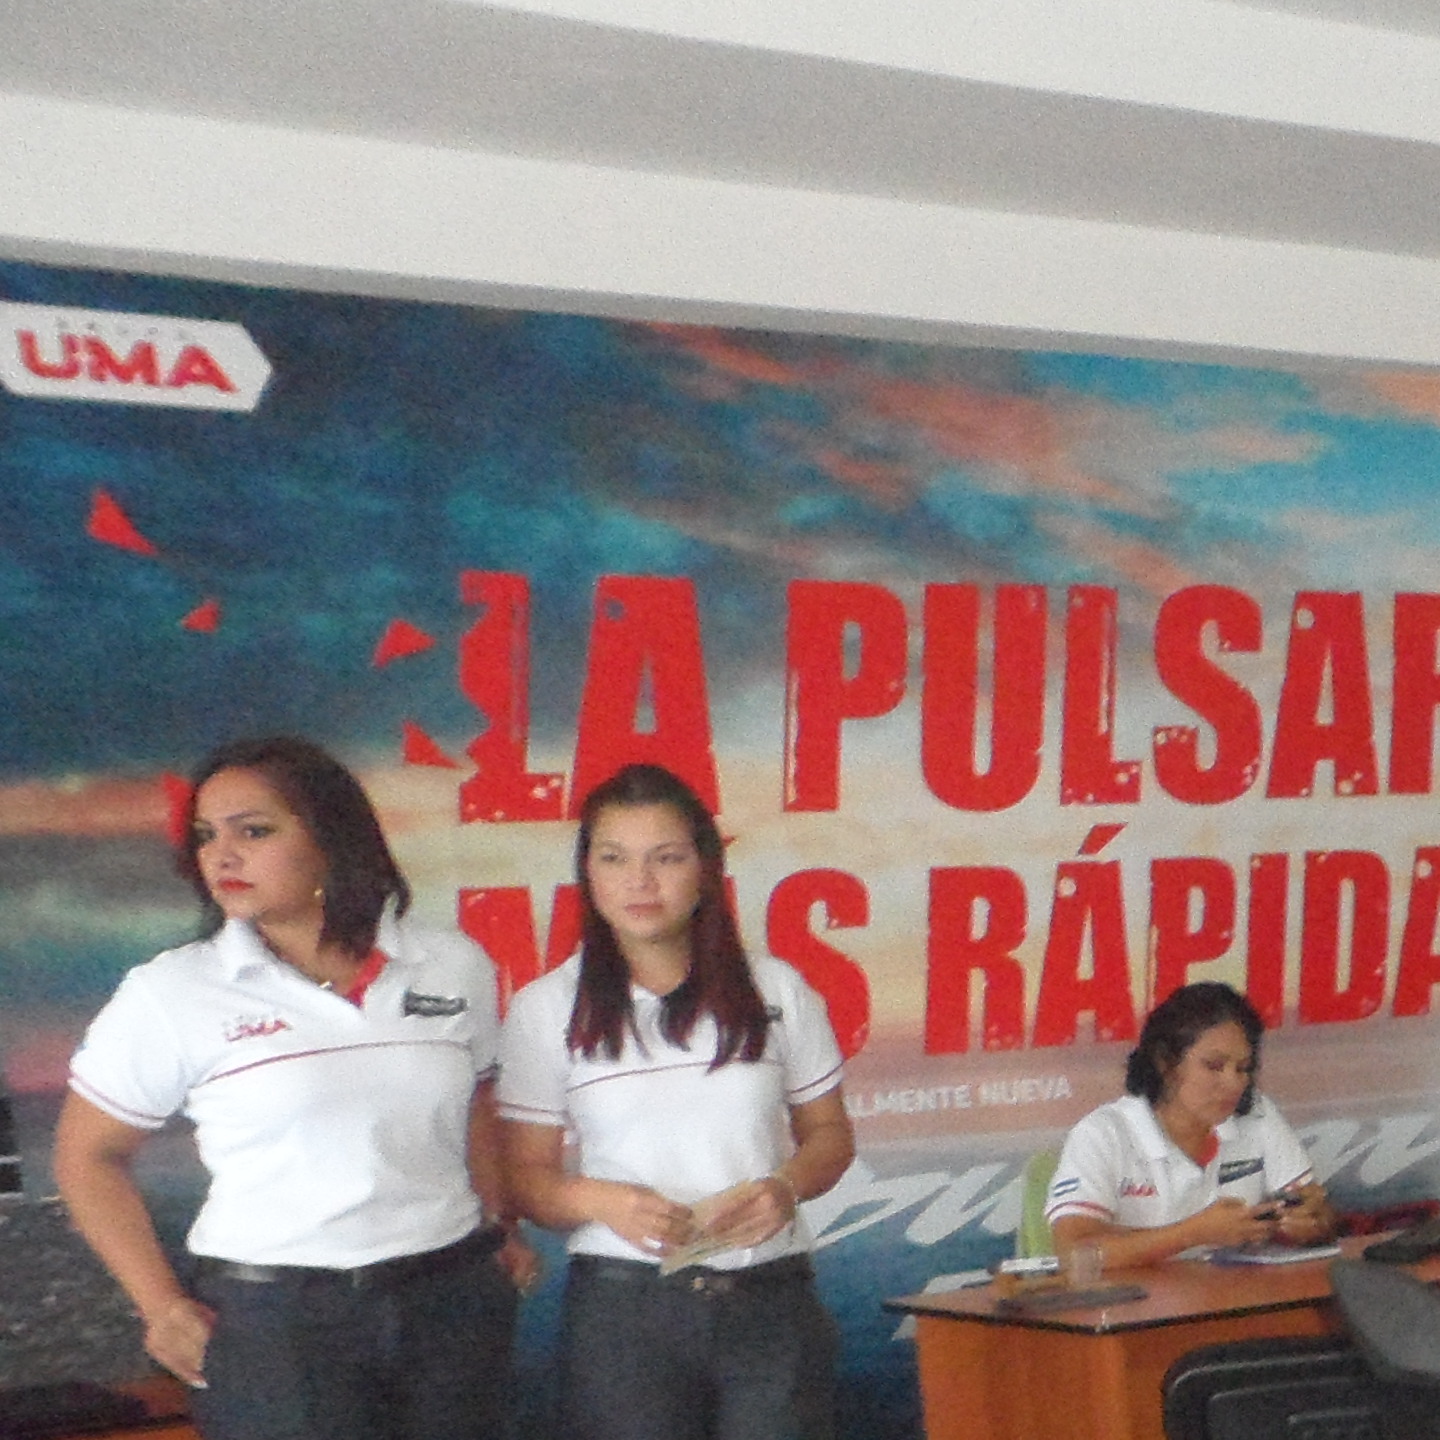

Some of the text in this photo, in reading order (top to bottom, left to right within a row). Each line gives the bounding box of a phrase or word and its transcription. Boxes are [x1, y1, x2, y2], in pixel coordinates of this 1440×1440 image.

[17, 328, 240, 394] UMA
[458, 569, 722, 824] LA
[458, 866, 870, 1060] MS
[978, 1075, 1073, 1106] NUEVA
